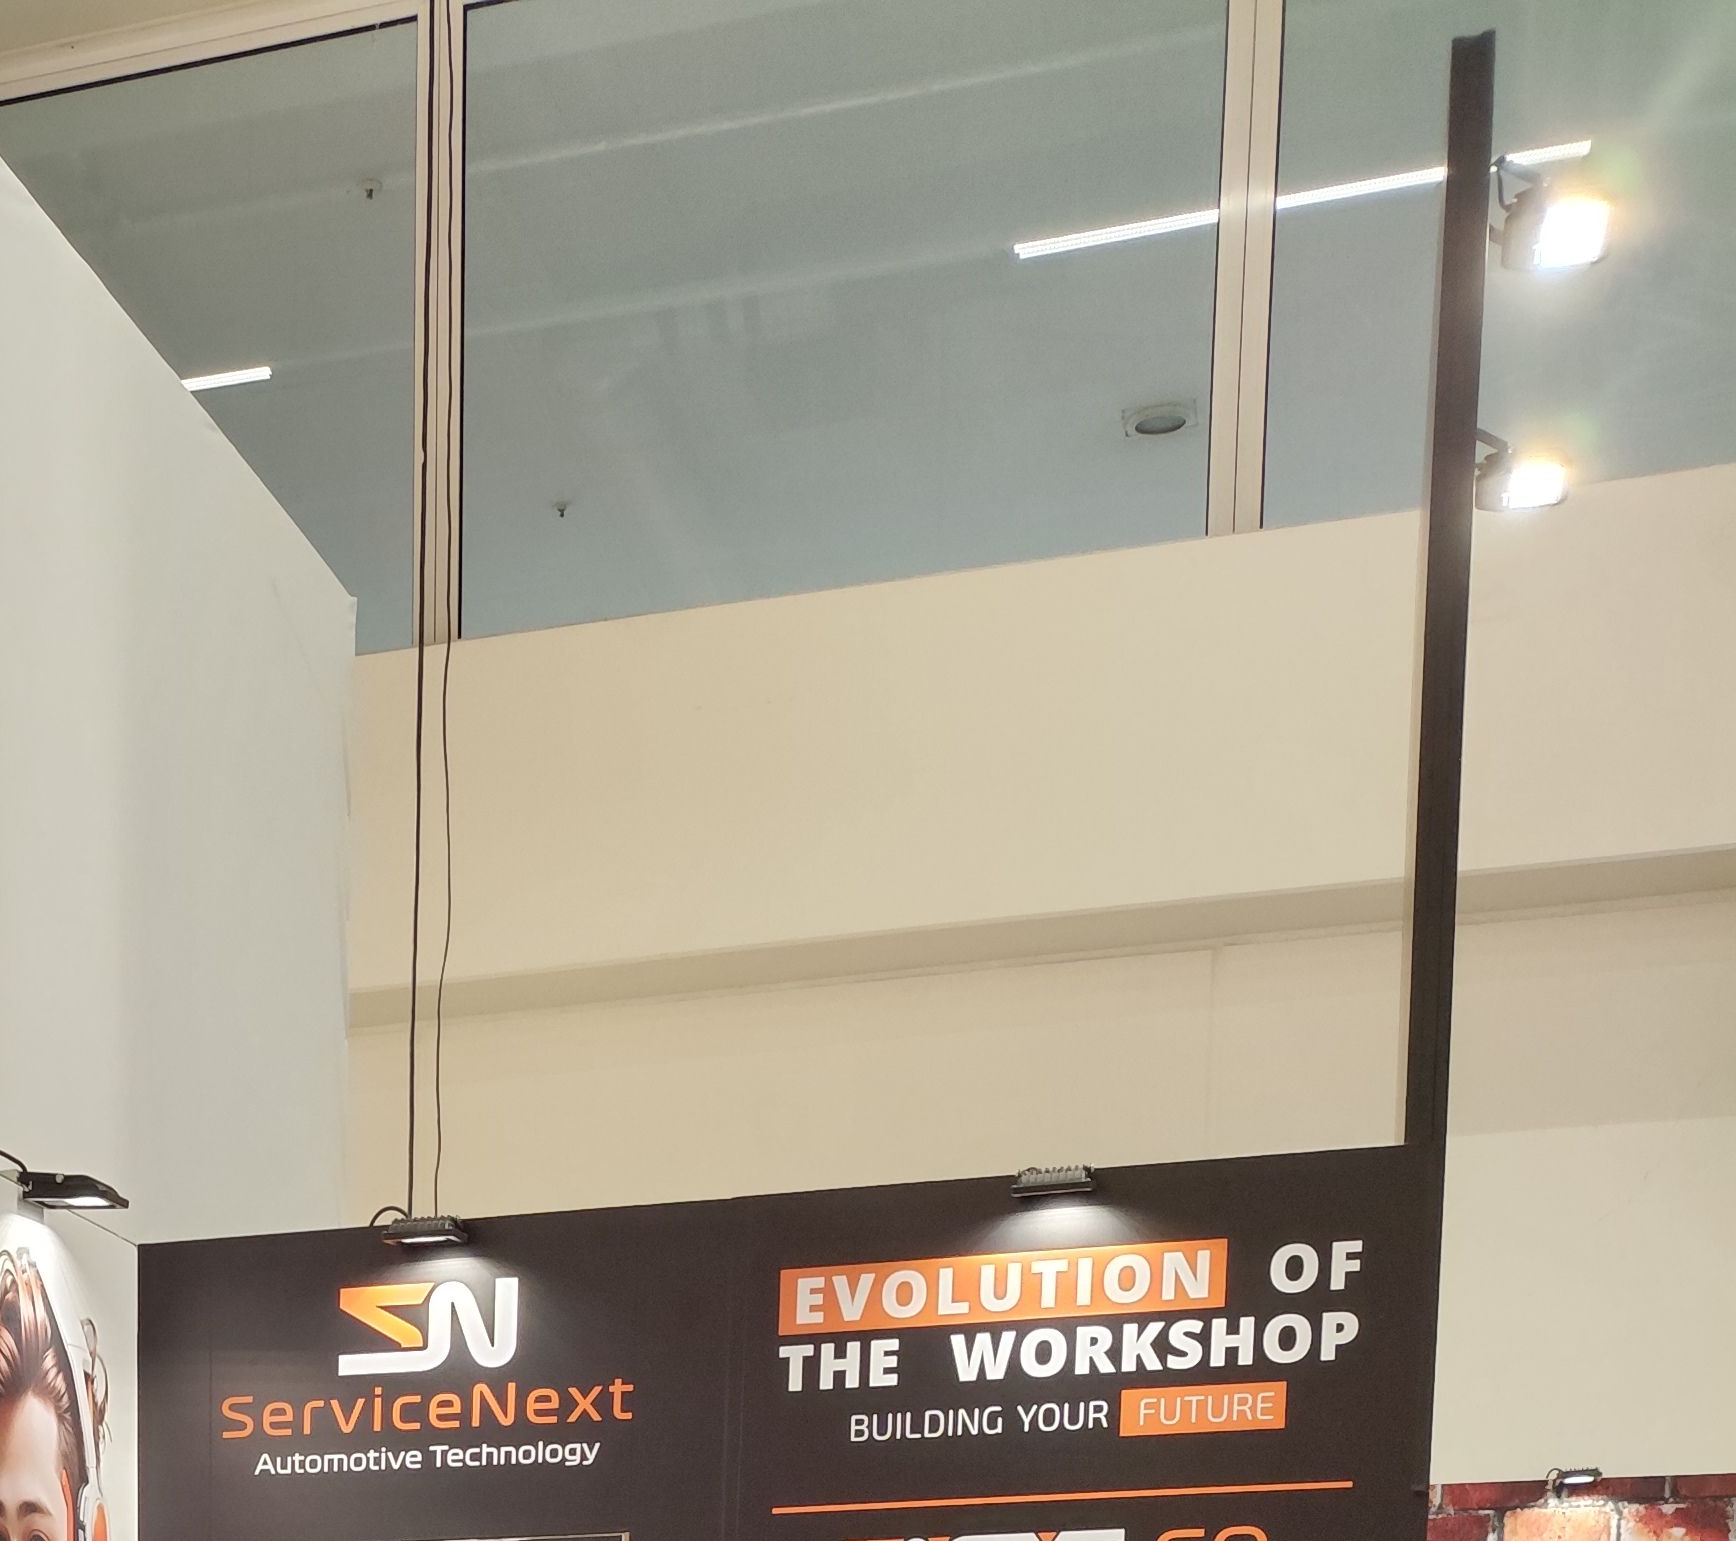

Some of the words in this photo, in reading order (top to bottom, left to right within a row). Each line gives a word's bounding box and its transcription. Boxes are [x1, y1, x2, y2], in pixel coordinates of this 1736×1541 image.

[794, 1247, 1212, 1326] EVOLUTION
[1269, 1239, 1364, 1295] OF
[778, 1337, 901, 1392] THE
[950, 1310, 1361, 1383] WORKSHOP
[220, 1377, 635, 1440] ServiceNext
[848, 1405, 1004, 1443] BUILDING
[1015, 1400, 1110, 1433] YOUR
[1138, 1391, 1277, 1426] FUTURE
[253, 1444, 423, 1477] Automotive
[428, 1439, 602, 1468] Technology
